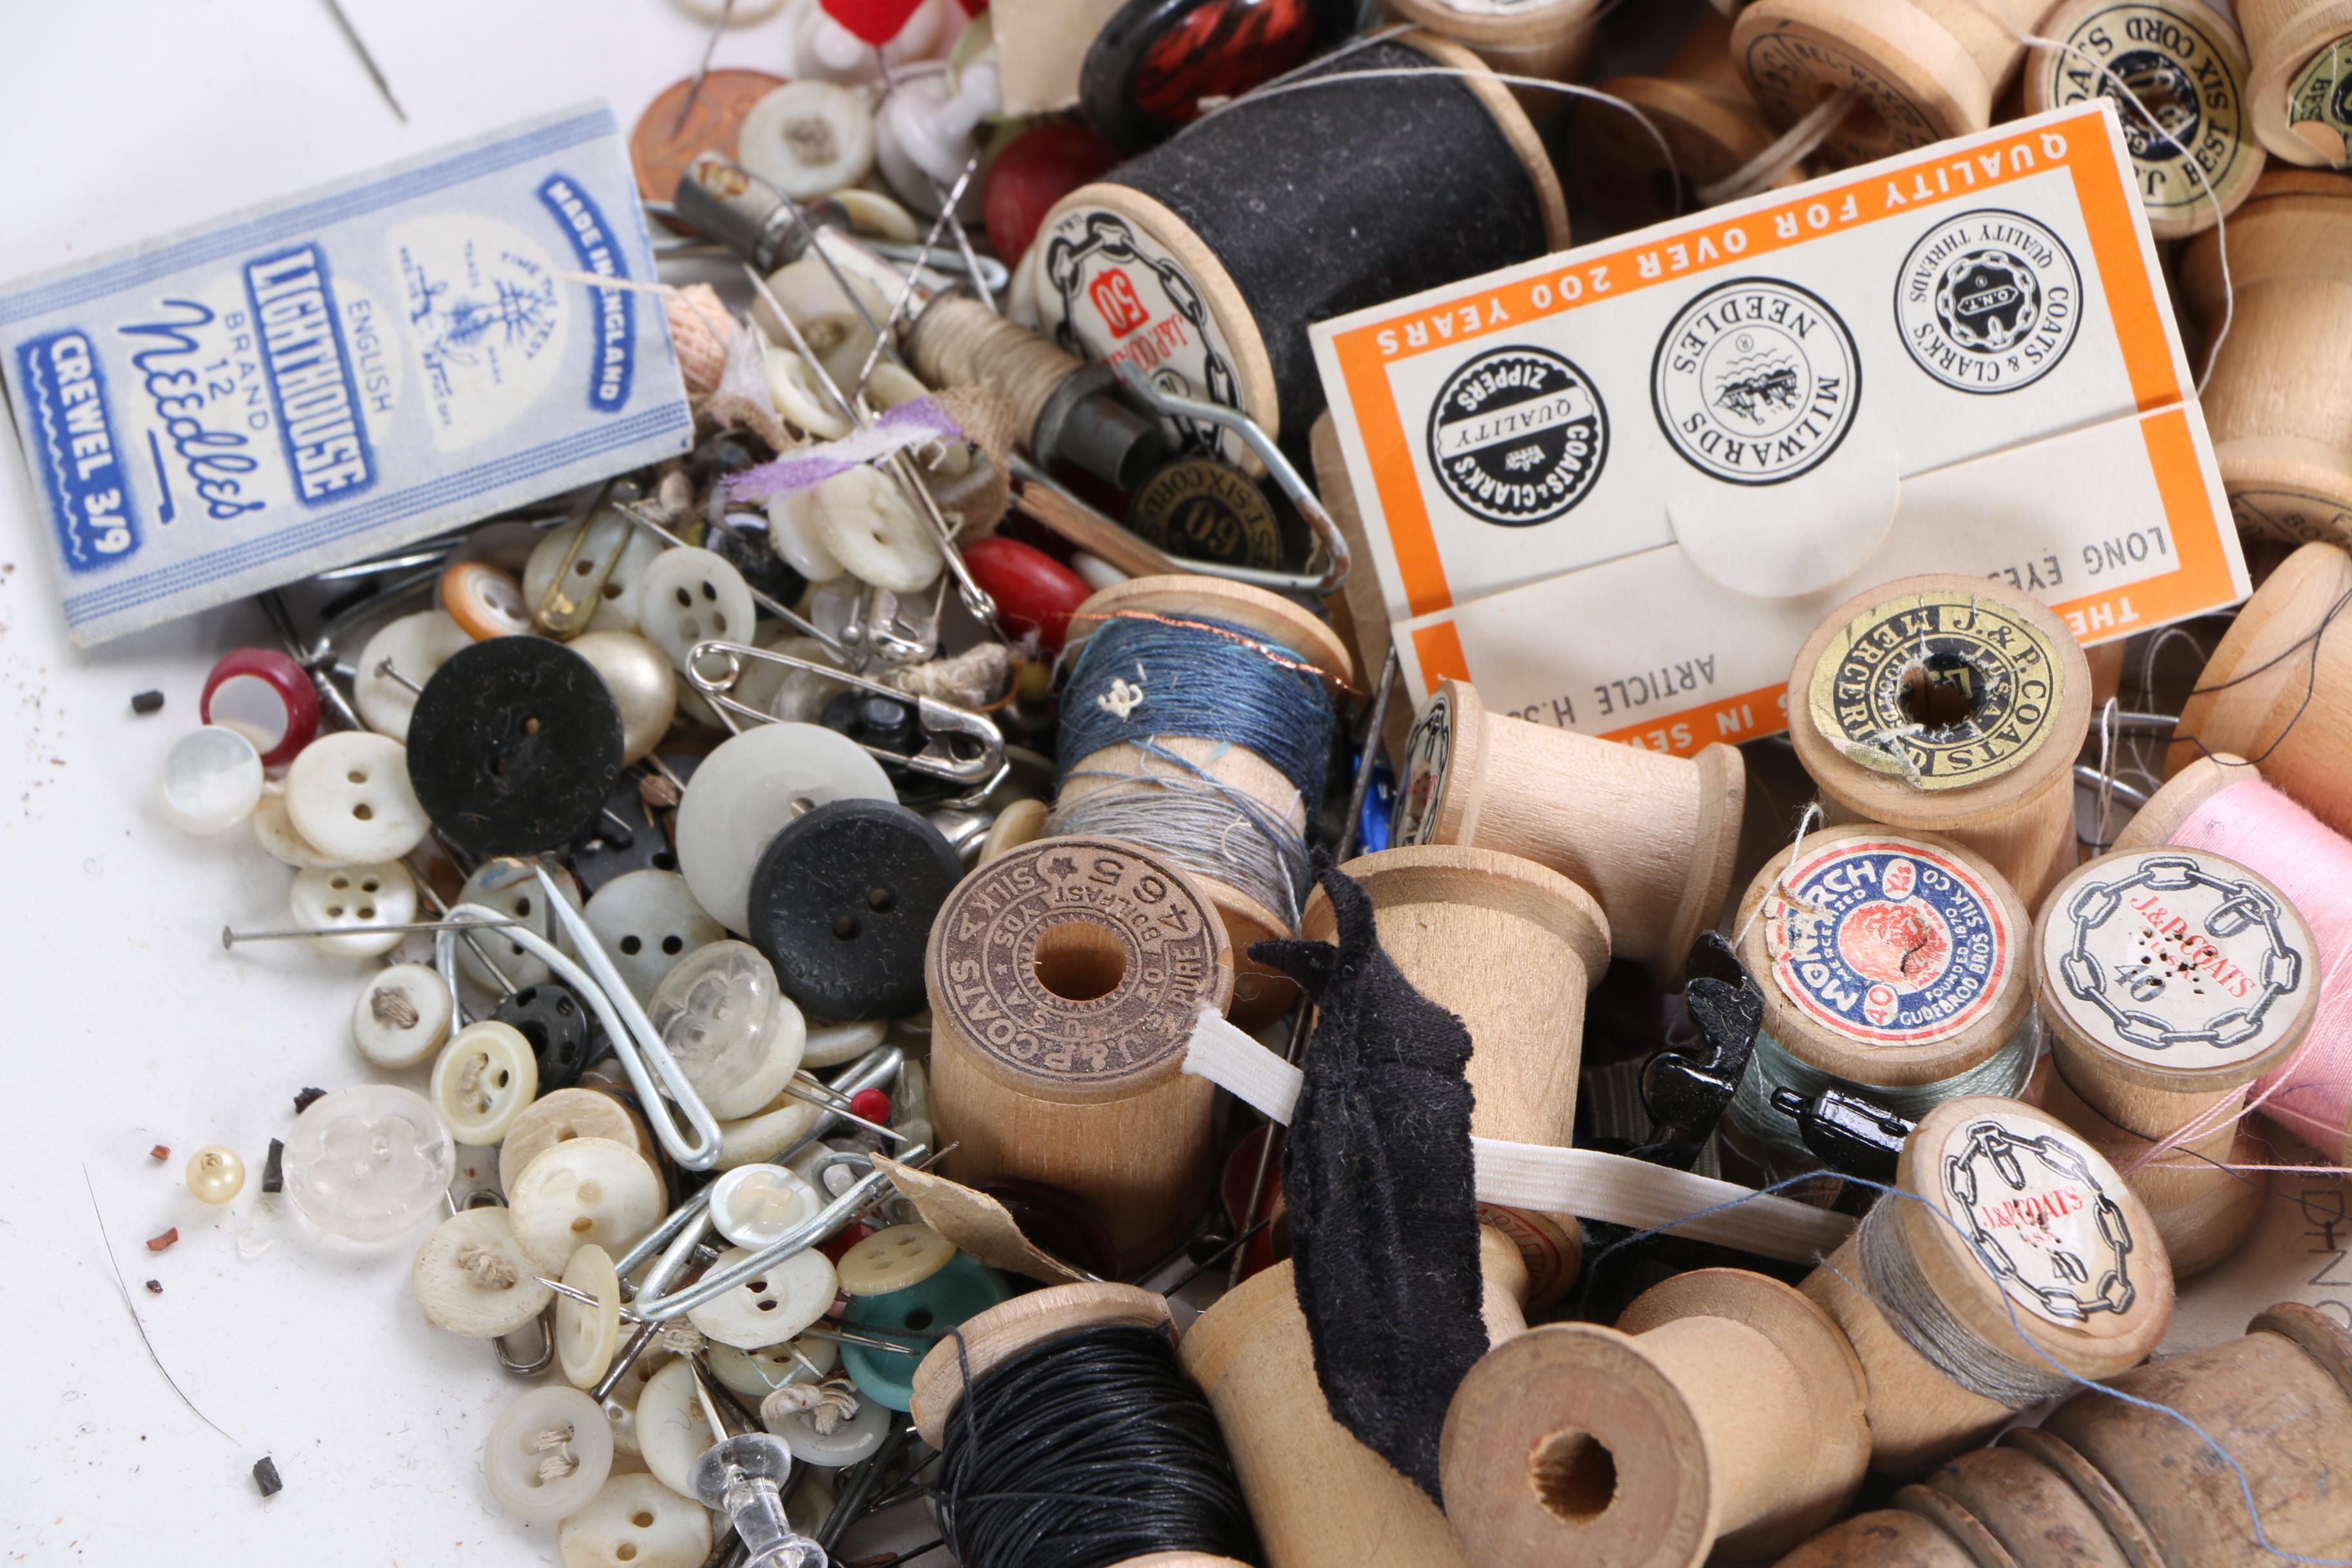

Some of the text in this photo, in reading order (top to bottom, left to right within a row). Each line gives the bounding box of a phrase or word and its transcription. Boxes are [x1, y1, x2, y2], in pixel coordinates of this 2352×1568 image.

[2125, 16, 2195, 59] CORD
[2192, 56, 2230, 110] SIX
[2181, 119, 2231, 186] BEST
[1376, 132, 2068, 355] QUALITY FOR OVER 200 YEARS
[1909, 223, 2053, 303] QUALITY THREADS
[547, 179, 627, 402] MADE IN ENGLAND
[1095, 273, 1144, 328] 50
[1965, 289, 2010, 311] O.N.T.
[347, 299, 395, 415] ENGLISH
[1673, 295, 1818, 375] NEEDLES
[1913, 286, 2069, 382] COATS & CLARK'S
[204, 357, 235, 401] 12
[223, 310, 269, 432] BRAND
[248, 248, 368, 500] LIGHTHOUSE
[1456, 364, 1548, 412] ZIPPERS
[50, 335, 132, 554] CREWEL 3/9
[1455, 398, 1572, 449] QUALITY
[1682, 375, 1841, 468] MILWARDS
[1143, 467, 1204, 516] CORD
[1206, 469, 1251, 509] SIX
[1184, 500, 1240, 557] 60
[2082, 525, 2167, 576] LONG
[1988, 625, 2016, 650] &
[2064, 597, 2140, 636] THE
[1593, 653, 1716, 716] ARTICLE
[1837, 609, 1934, 768] MERCERID
[1715, 704, 1755, 738] IN
[1947, 678, 2048, 771] COATS
[970, 865, 1036, 918] SILK
[1054, 886, 1161, 943] BOILFAST
[1949, 890, 1984, 929] SILK
[994, 904, 1042, 948] YDS
[1970, 932, 1990, 975] BROS
[1168, 945, 1201, 1003] PURE
[1925, 906, 1970, 1002] FOUNDED 1870
[949, 958, 1040, 1059] COATS
[1868, 985, 1894, 1025] 40
[1899, 976, 1979, 1026] GUDEBROD
[2113, 963, 2167, 1003] 40
